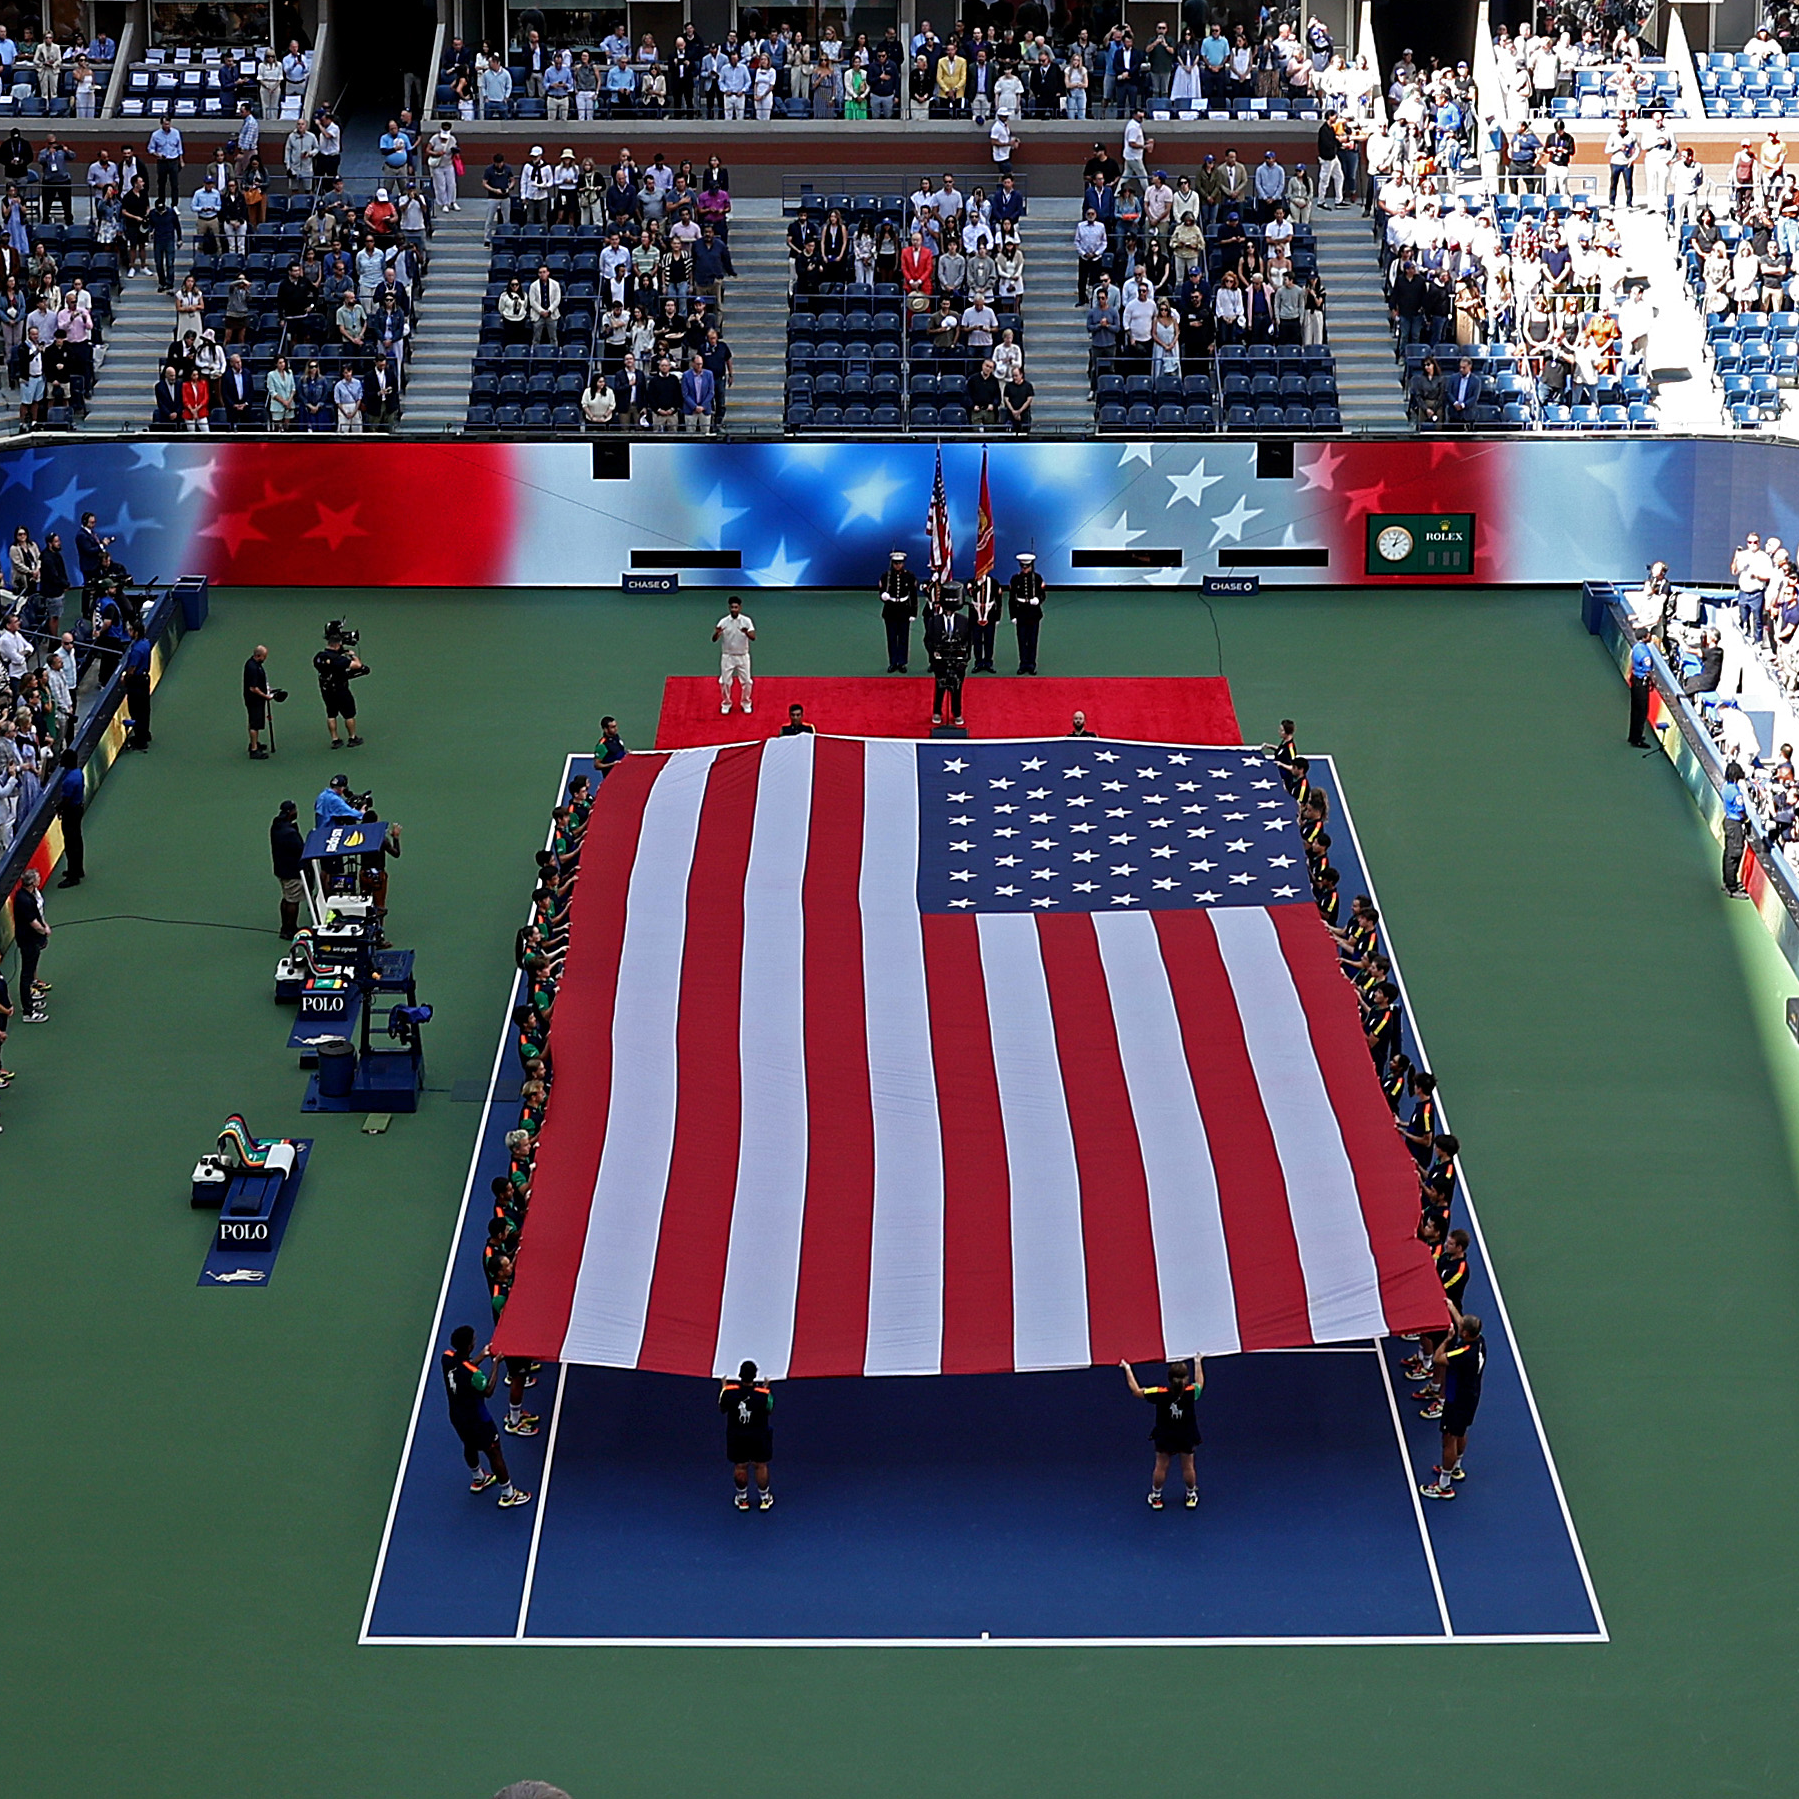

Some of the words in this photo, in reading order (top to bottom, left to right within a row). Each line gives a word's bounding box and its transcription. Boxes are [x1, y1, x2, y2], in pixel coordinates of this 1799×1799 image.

[1426, 532, 1463, 542] ROLEX
[628, 580, 660, 589] CHASE
[1210, 582, 1242, 591] CHASE
[302, 996, 344, 1012] POLO
[220, 1223, 268, 1240] POLO
